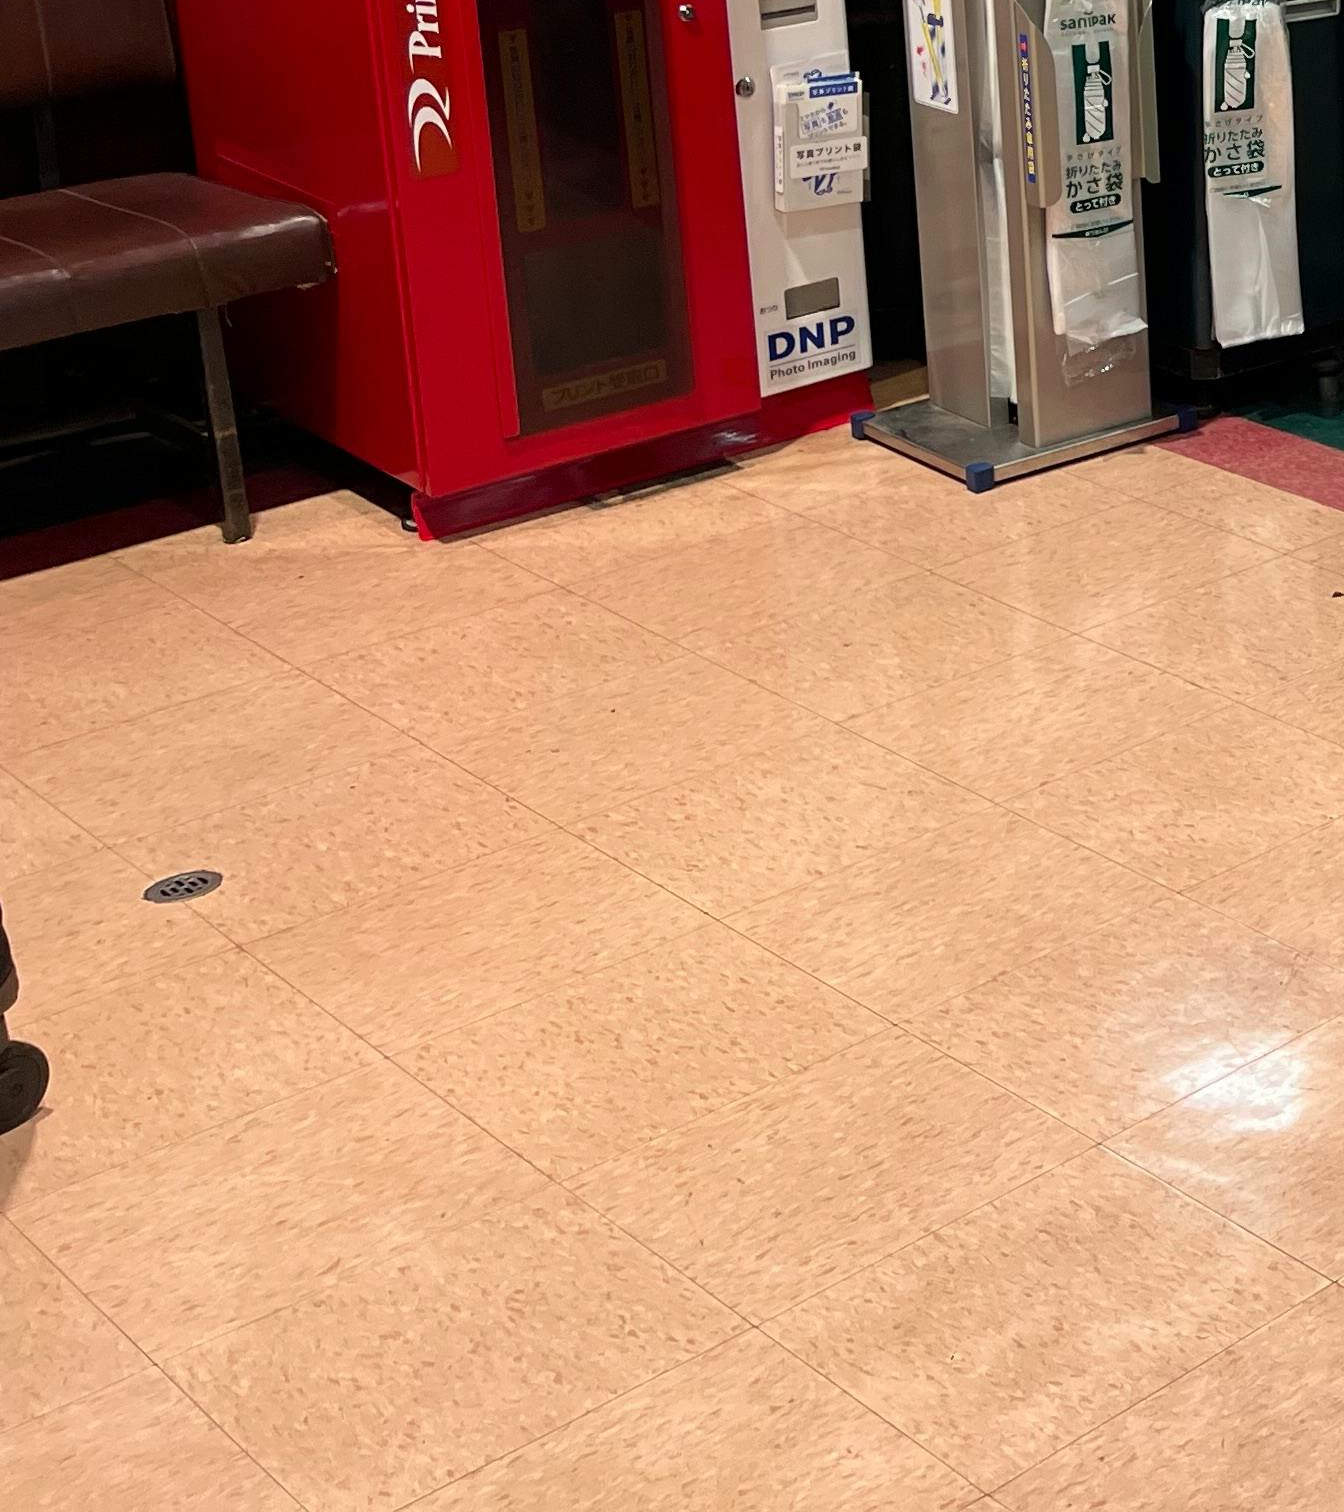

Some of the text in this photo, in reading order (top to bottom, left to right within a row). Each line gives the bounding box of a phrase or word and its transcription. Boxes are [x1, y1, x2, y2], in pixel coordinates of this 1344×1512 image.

[1059, 10, 1117, 31] sanipak
[1204, 139, 1265, 164] かさ袋
[1065, 161, 1122, 181] 折りたたみ
[1066, 174, 1124, 199] かさ袋
[767, 315, 856, 362] DNP
[769, 350, 857, 381] Photo Imaging
